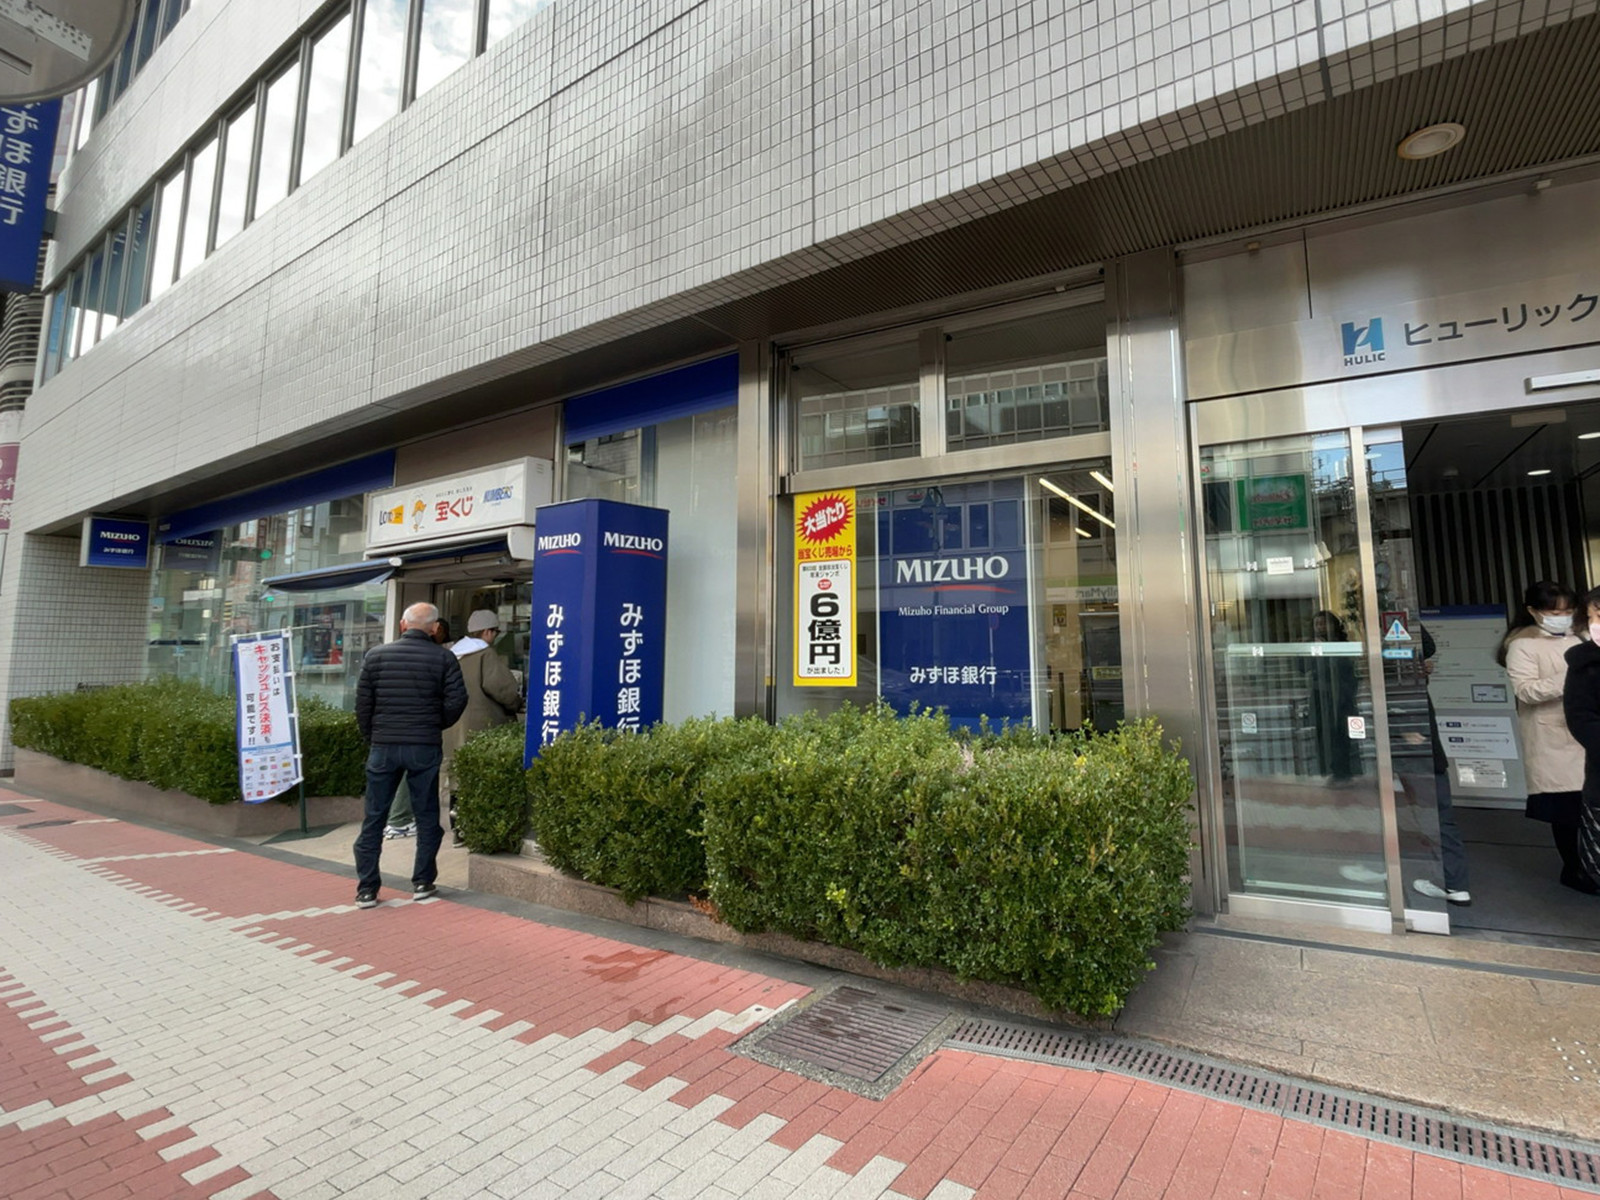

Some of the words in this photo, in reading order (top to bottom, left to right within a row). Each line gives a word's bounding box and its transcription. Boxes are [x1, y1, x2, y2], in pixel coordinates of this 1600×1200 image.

[1403, 293, 1599, 347] ヒューリック
[1343, 352, 1386, 367] HULIC
[434, 496, 473, 522] 宝くじ
[804, 501, 846, 537] 大当たり
[100, 531, 140, 542] MIZUHO
[537, 532, 581, 551] MIZUHO
[603, 531, 663, 552] MIZUHO
[896, 555, 1009, 584] MIZUHO
[898, 606, 932, 616] Mizuho
[934, 604, 976, 615] Financial
[978, 603, 1009, 616] Group
[808, 592, 842, 665] 6億円
[541, 603, 564, 747] みずほ銀行
[909, 665, 997, 685] みずほ銀行
